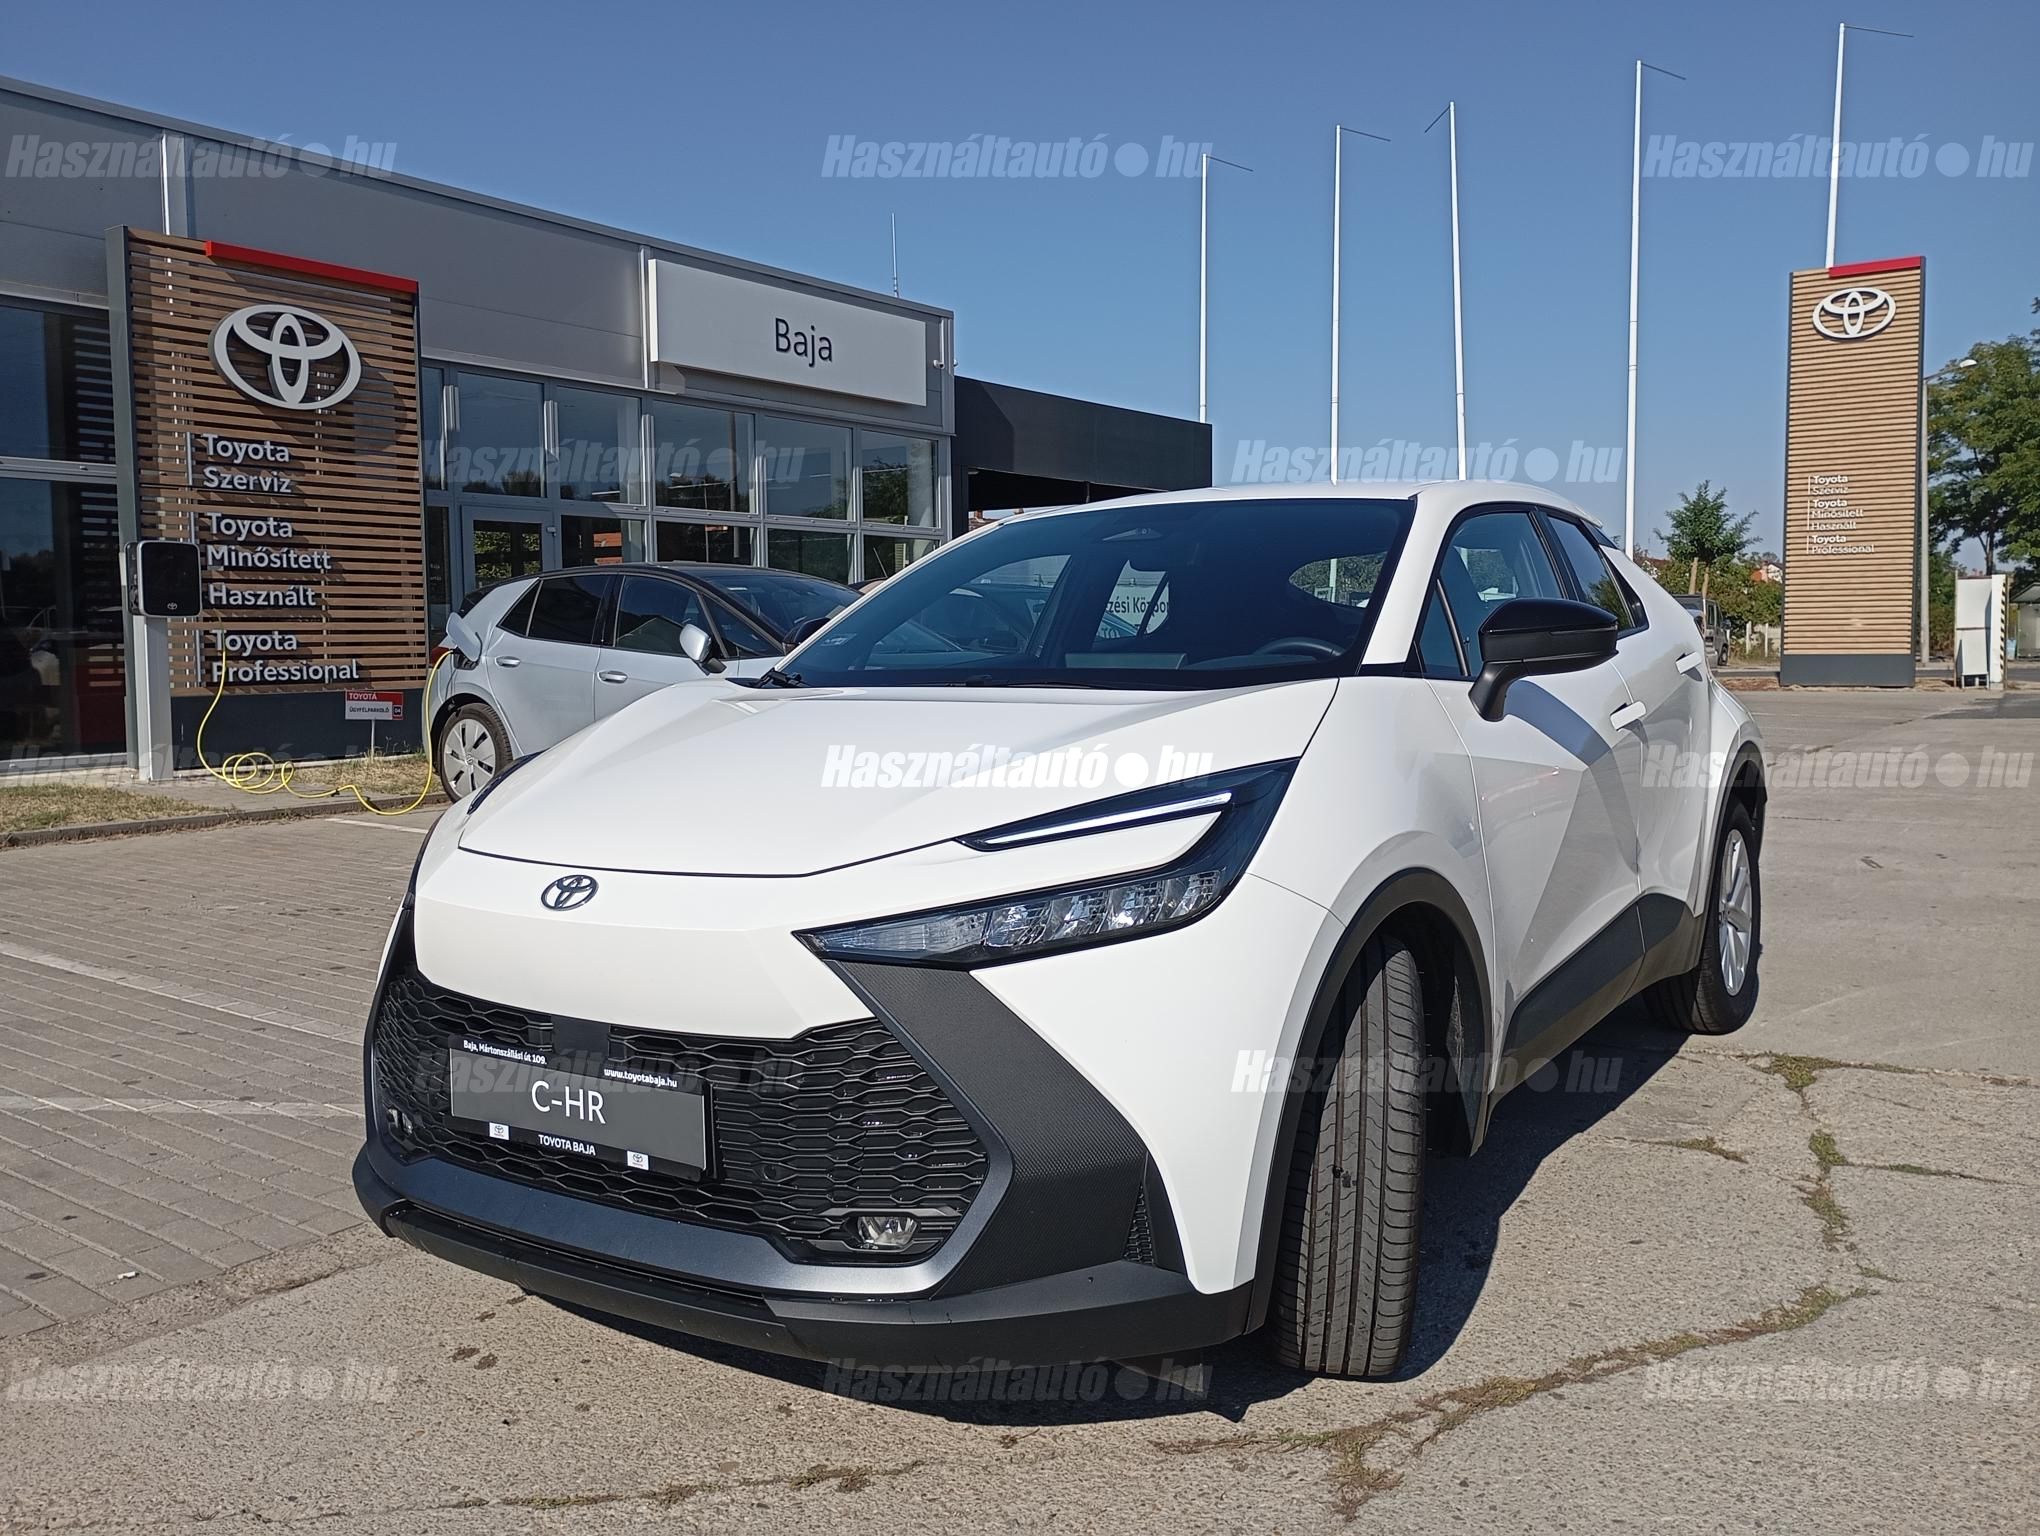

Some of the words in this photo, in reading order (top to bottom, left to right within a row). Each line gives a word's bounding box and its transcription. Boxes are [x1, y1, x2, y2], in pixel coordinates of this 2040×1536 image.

[775, 317, 833, 368] Baja
[203, 433, 290, 464] Toyota
[203, 466, 292, 493] Szerviz
[1812, 475, 1848, 485] Toyota
[1812, 499, 1848, 509] Toyota
[206, 512, 293, 541] Toyota
[1811, 535, 1847, 545] Toyota
[1811, 544, 1875, 555] Professional
[206, 545, 332, 570] Minősített
[208, 582, 317, 607] Használt
[212, 629, 298, 653] Toyota
[211, 659, 359, 683] Professional
[348, 692, 378, 700] TOYOTA
[463, 1040, 479, 1052] Baja,
[532, 1054, 548, 1065] 109.
[603, 1068, 678, 1088] www.toyotabaja.hu
[530, 1080, 606, 1124] C-HR
[538, 1134, 572, 1151] TOYOTA
[572, 1141, 596, 1156] BAJA
